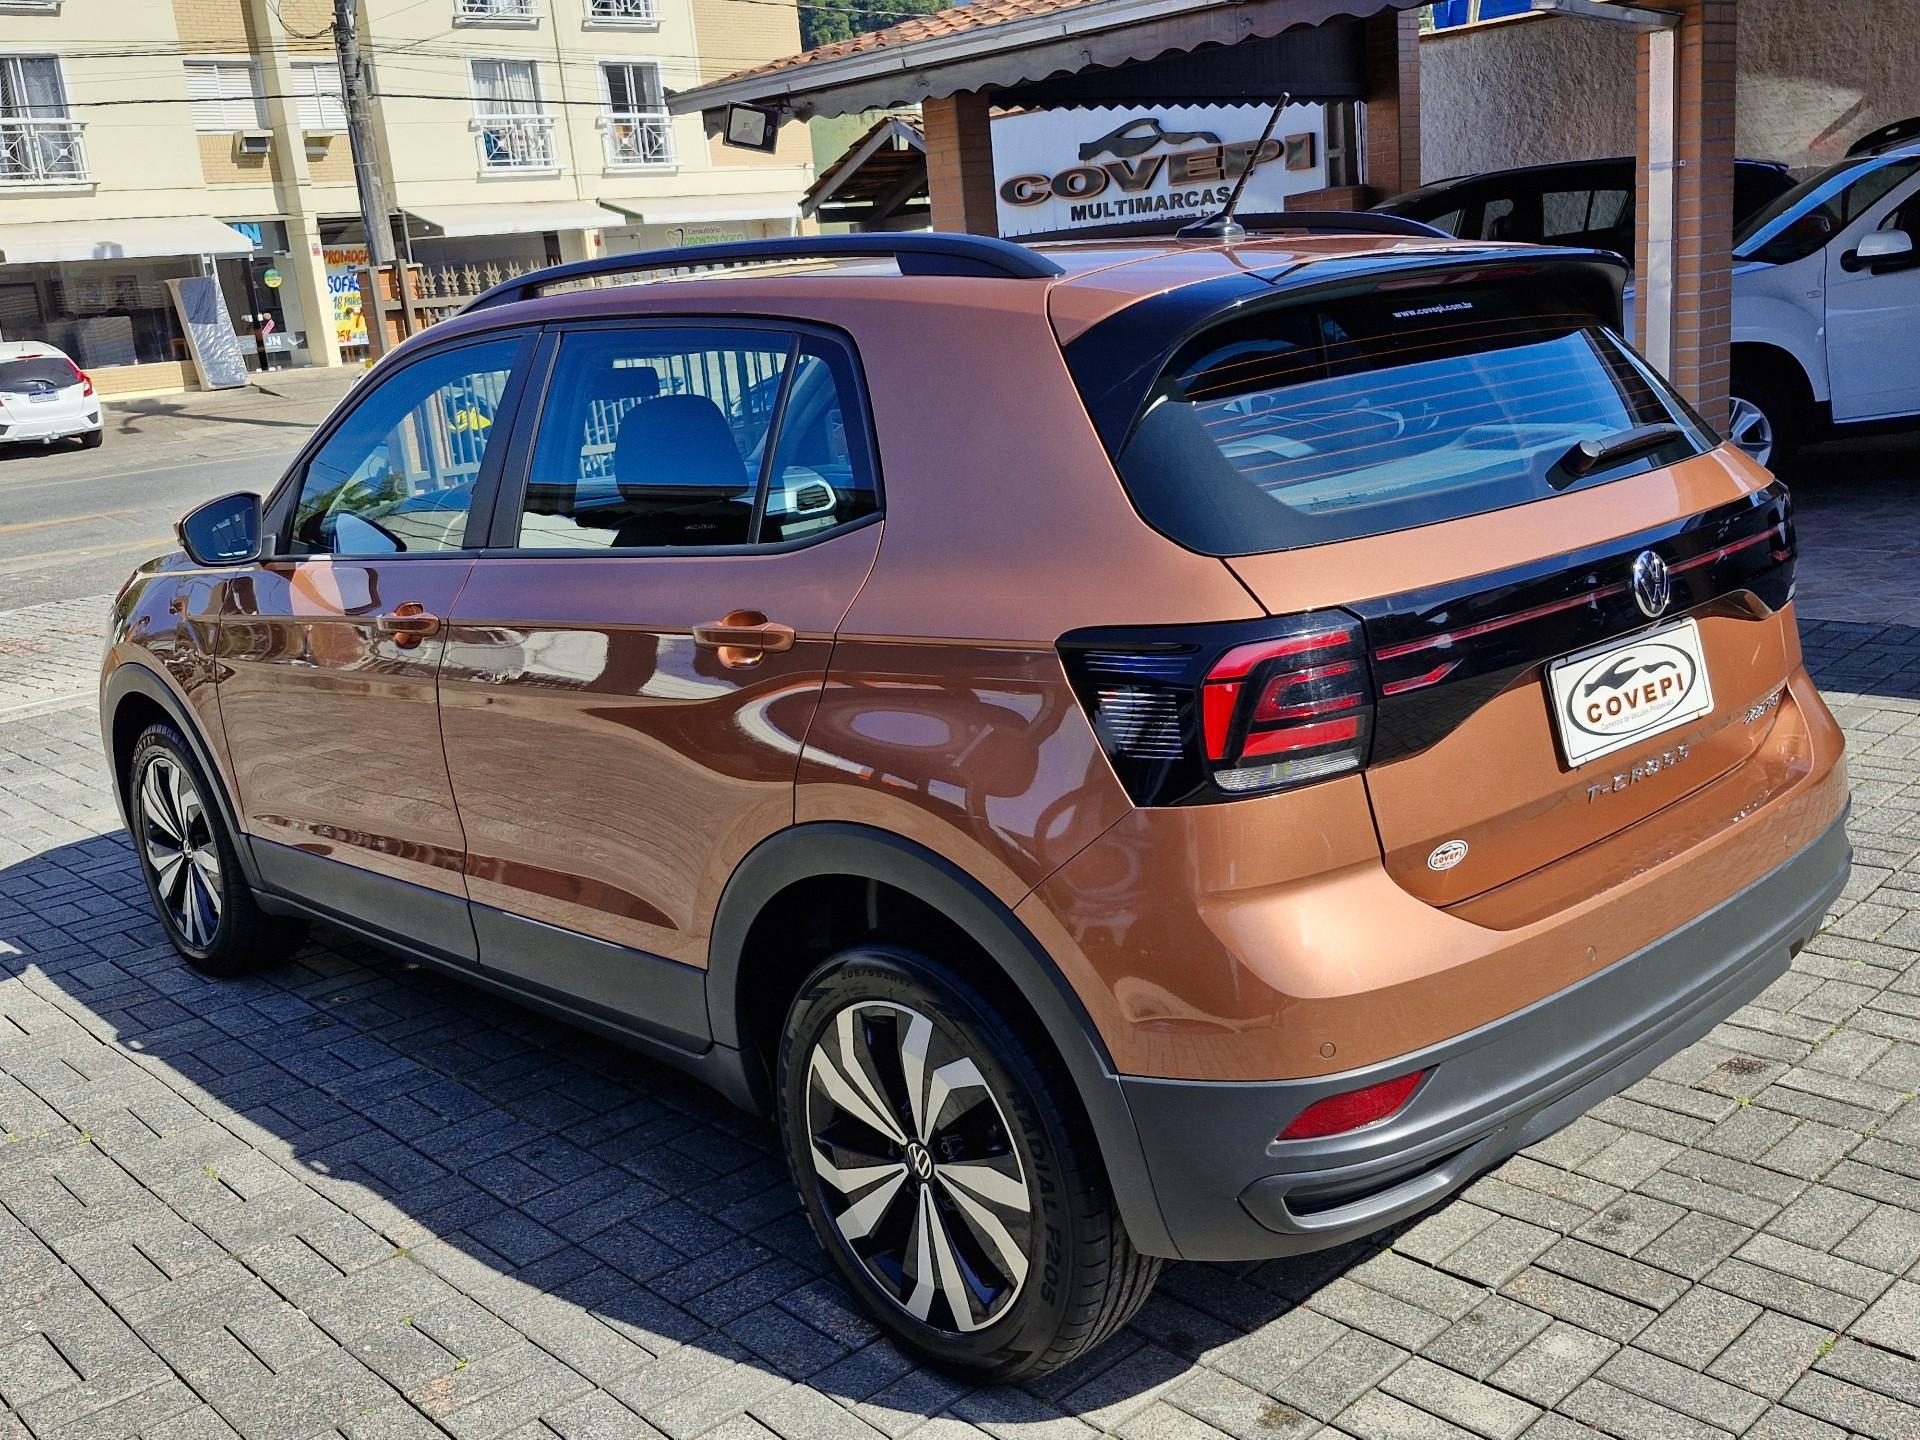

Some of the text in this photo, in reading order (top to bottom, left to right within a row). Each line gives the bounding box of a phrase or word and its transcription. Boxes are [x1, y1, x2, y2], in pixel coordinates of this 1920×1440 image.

[999, 132, 1315, 206] COVEPI
[1071, 186, 1231, 222] MULTIMARCAS
[1392, 302, 1473, 318] www.covepi.com.br
[1586, 672, 1685, 724] COVEPI
[1433, 850, 1462, 866] COVEPI
